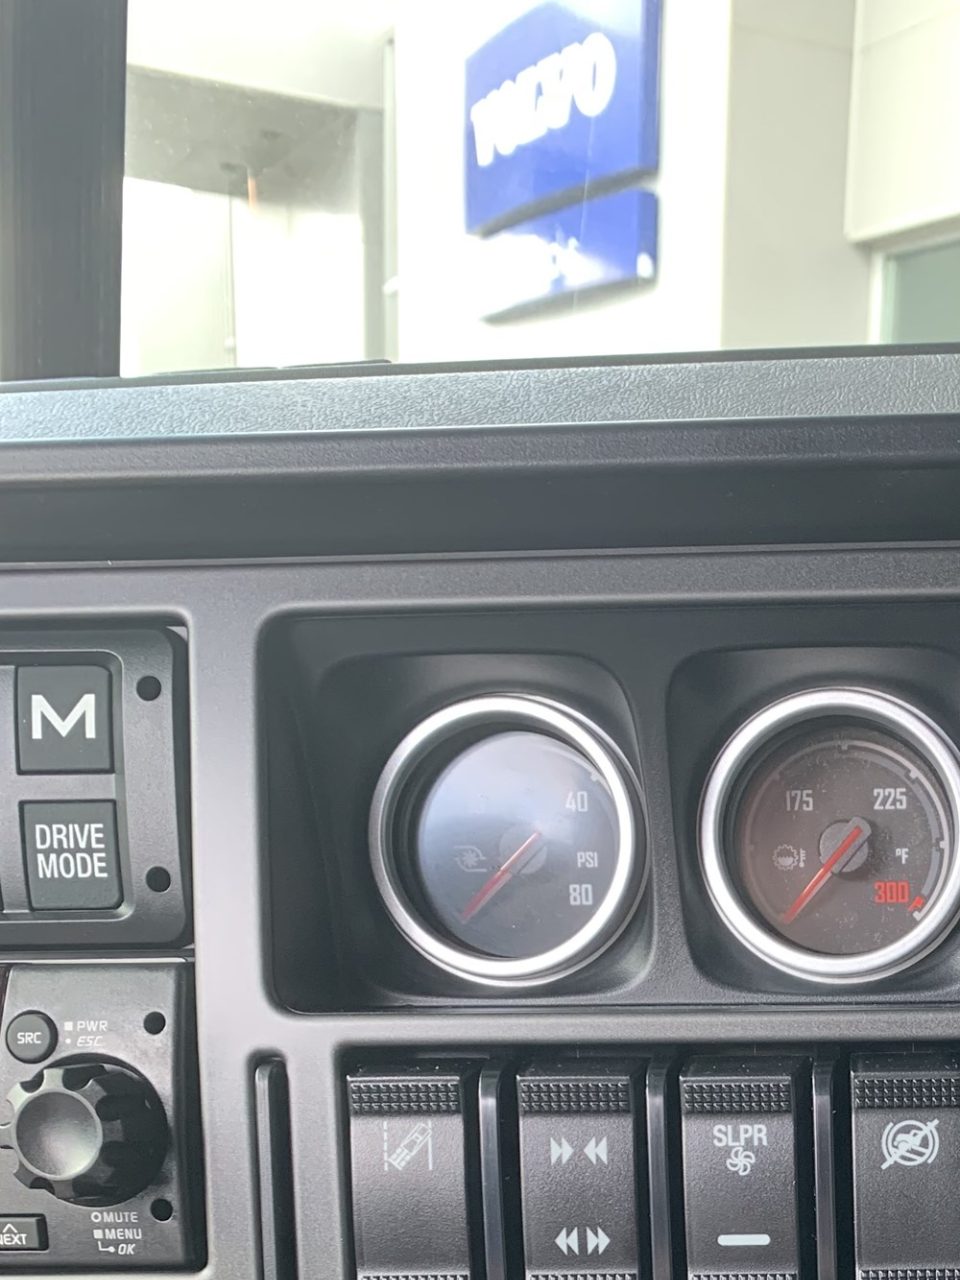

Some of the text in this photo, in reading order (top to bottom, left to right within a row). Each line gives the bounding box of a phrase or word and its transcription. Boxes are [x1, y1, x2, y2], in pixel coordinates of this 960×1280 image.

[31, 693, 96, 739] M
[565, 791, 589, 813] 40
[786, 789, 814, 812] 175
[872, 788, 908, 810] 225
[34, 823, 105, 850] DRIVE
[37, 852, 109, 879] MODE
[576, 851, 599, 868] PSI
[568, 883, 594, 906] 80
[873, 880, 910, 905] 300
[76, 1020, 108, 1033] PWR
[16, 1031, 43, 1045] SRC
[76, 1035, 103, 1047] ESC
[712, 1123, 768, 1147] SLPR
[102, 1211, 139, 1223] MUTE
[103, 1228, 143, 1240] MENU
[117, 1243, 136, 1256] OK
